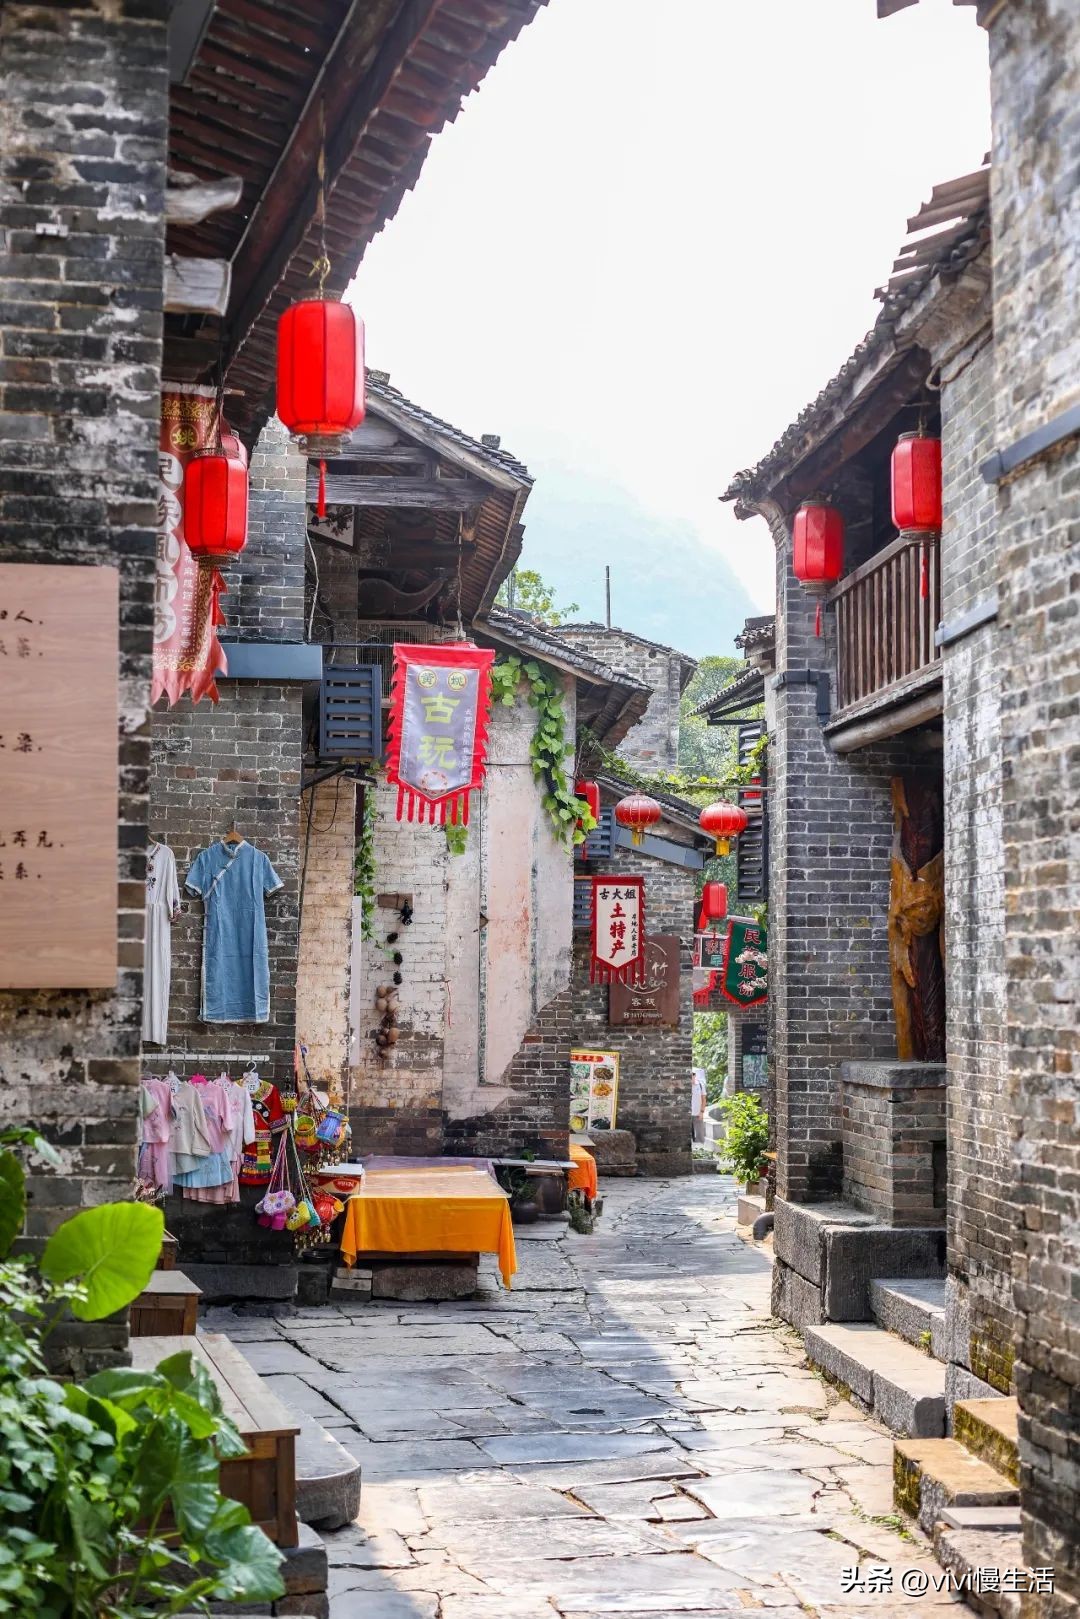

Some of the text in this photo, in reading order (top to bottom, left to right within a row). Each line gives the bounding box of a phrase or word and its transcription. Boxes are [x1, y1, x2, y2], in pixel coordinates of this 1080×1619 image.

[417, 691, 460, 769] 古玩
[599, 888, 637, 900] 古大姐
[609, 902, 627, 959] 土特产
